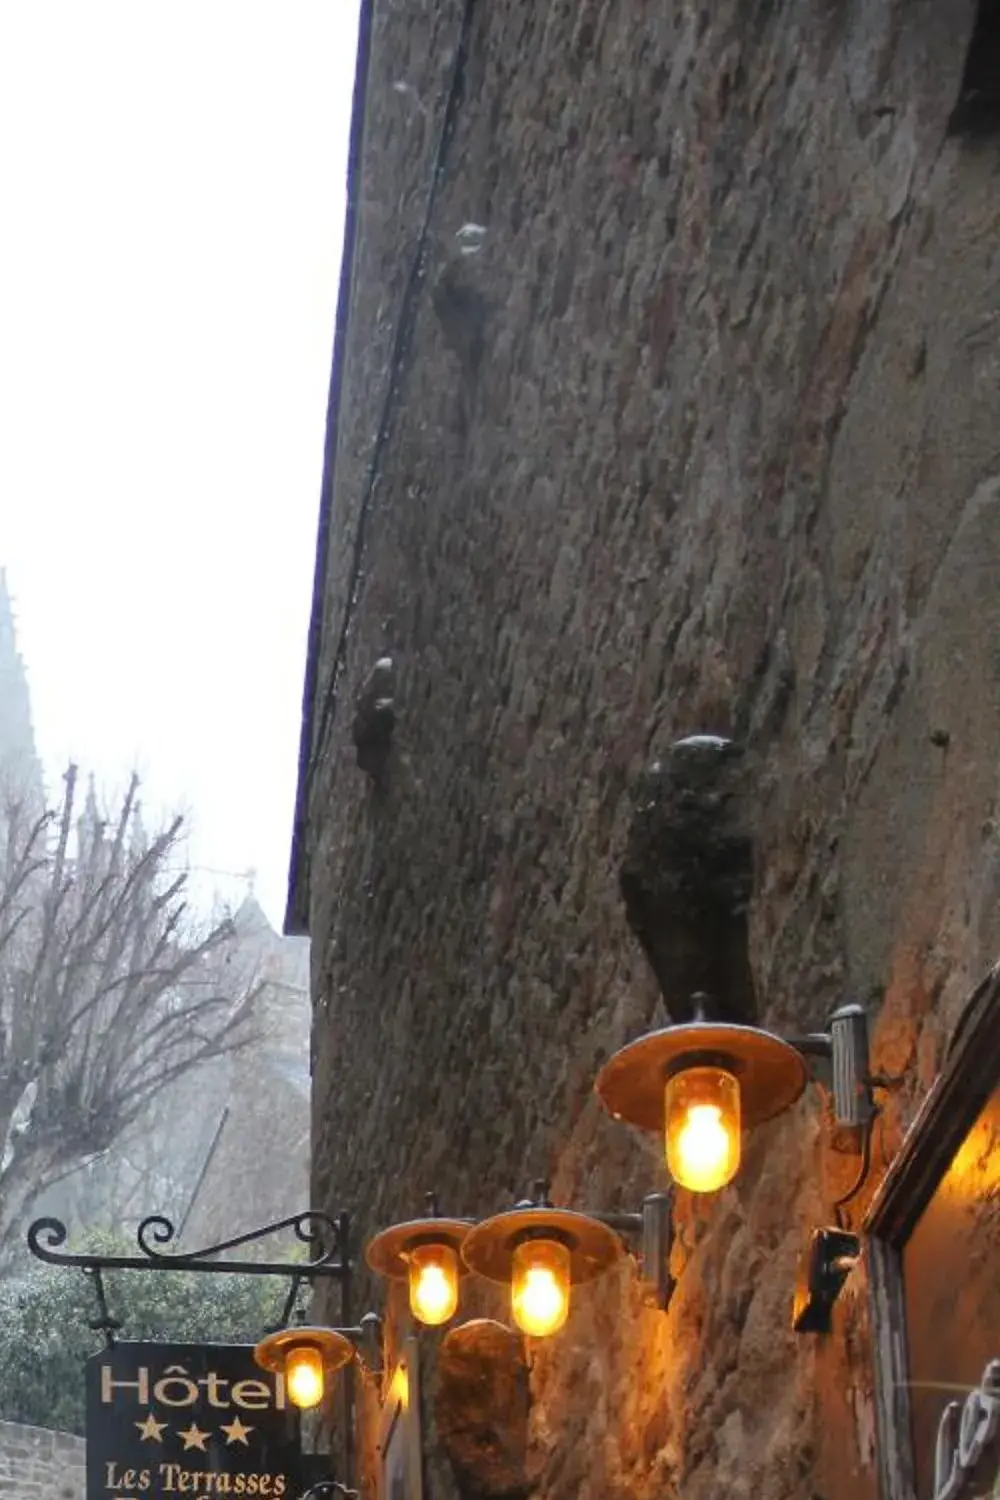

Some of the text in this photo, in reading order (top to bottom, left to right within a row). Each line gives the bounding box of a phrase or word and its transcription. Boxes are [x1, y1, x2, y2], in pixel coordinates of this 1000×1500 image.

[101, 1365, 285, 1410] Hôtel
[105, 1461, 287, 1496] Les Terrasses
